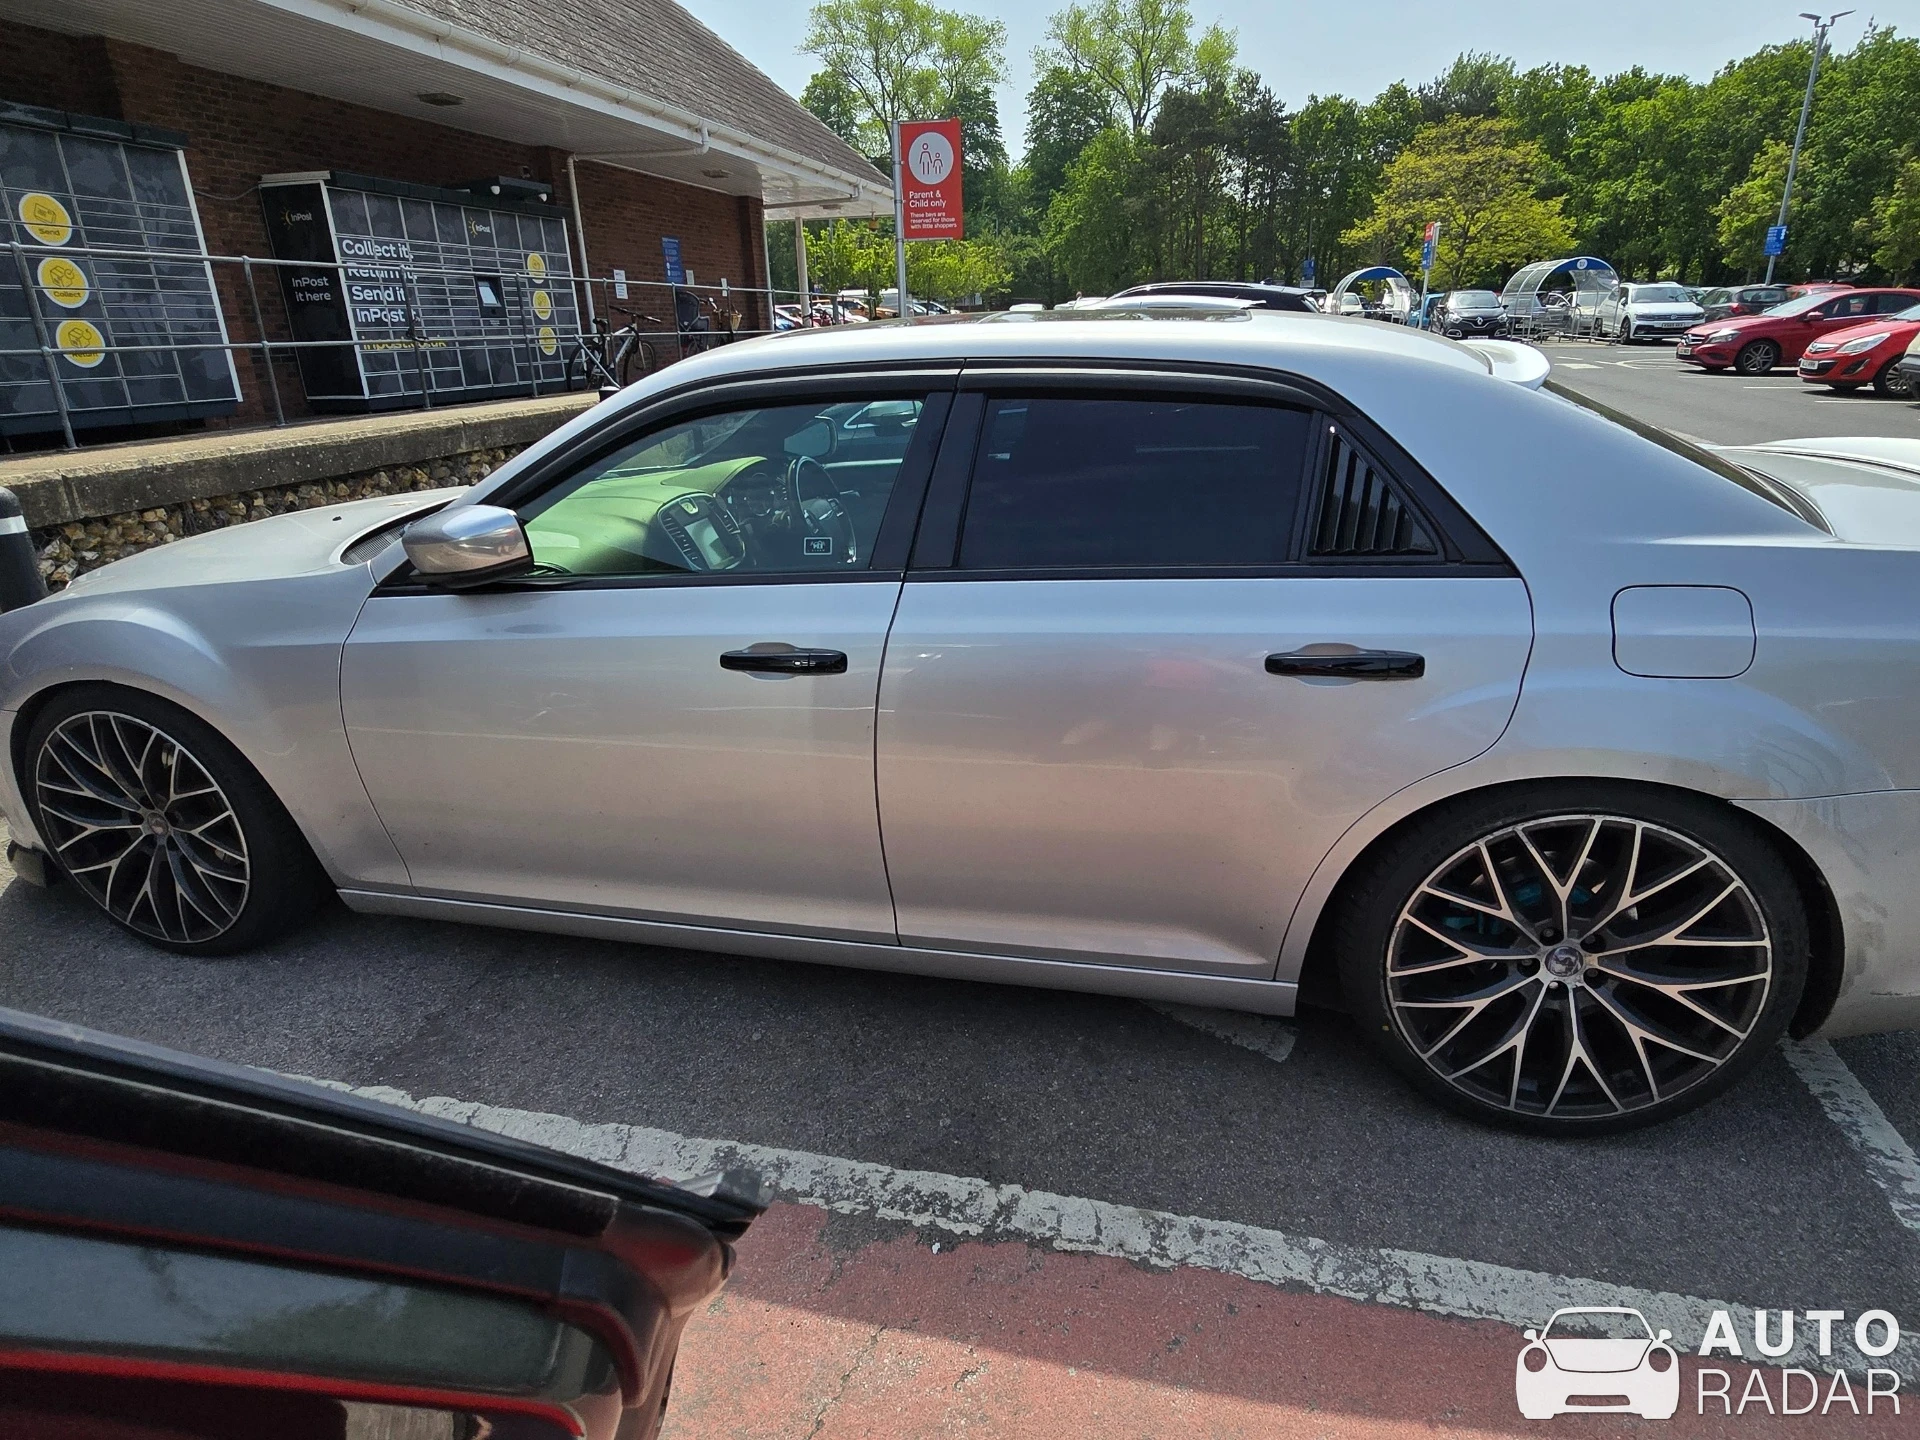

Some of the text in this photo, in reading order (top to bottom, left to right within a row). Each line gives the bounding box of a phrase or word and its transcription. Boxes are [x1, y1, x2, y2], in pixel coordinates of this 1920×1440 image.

[909, 191, 933, 199] Parent
[930, 199, 946, 208] only
[291, 212, 312, 222] InPost
[39, 228, 60, 236] Send
[342, 239, 414, 259] Collect it.
[292, 276, 329, 287] InPost
[295, 292, 331, 302] it here
[352, 286, 406, 302] Send it
[356, 309, 405, 323] InPost
